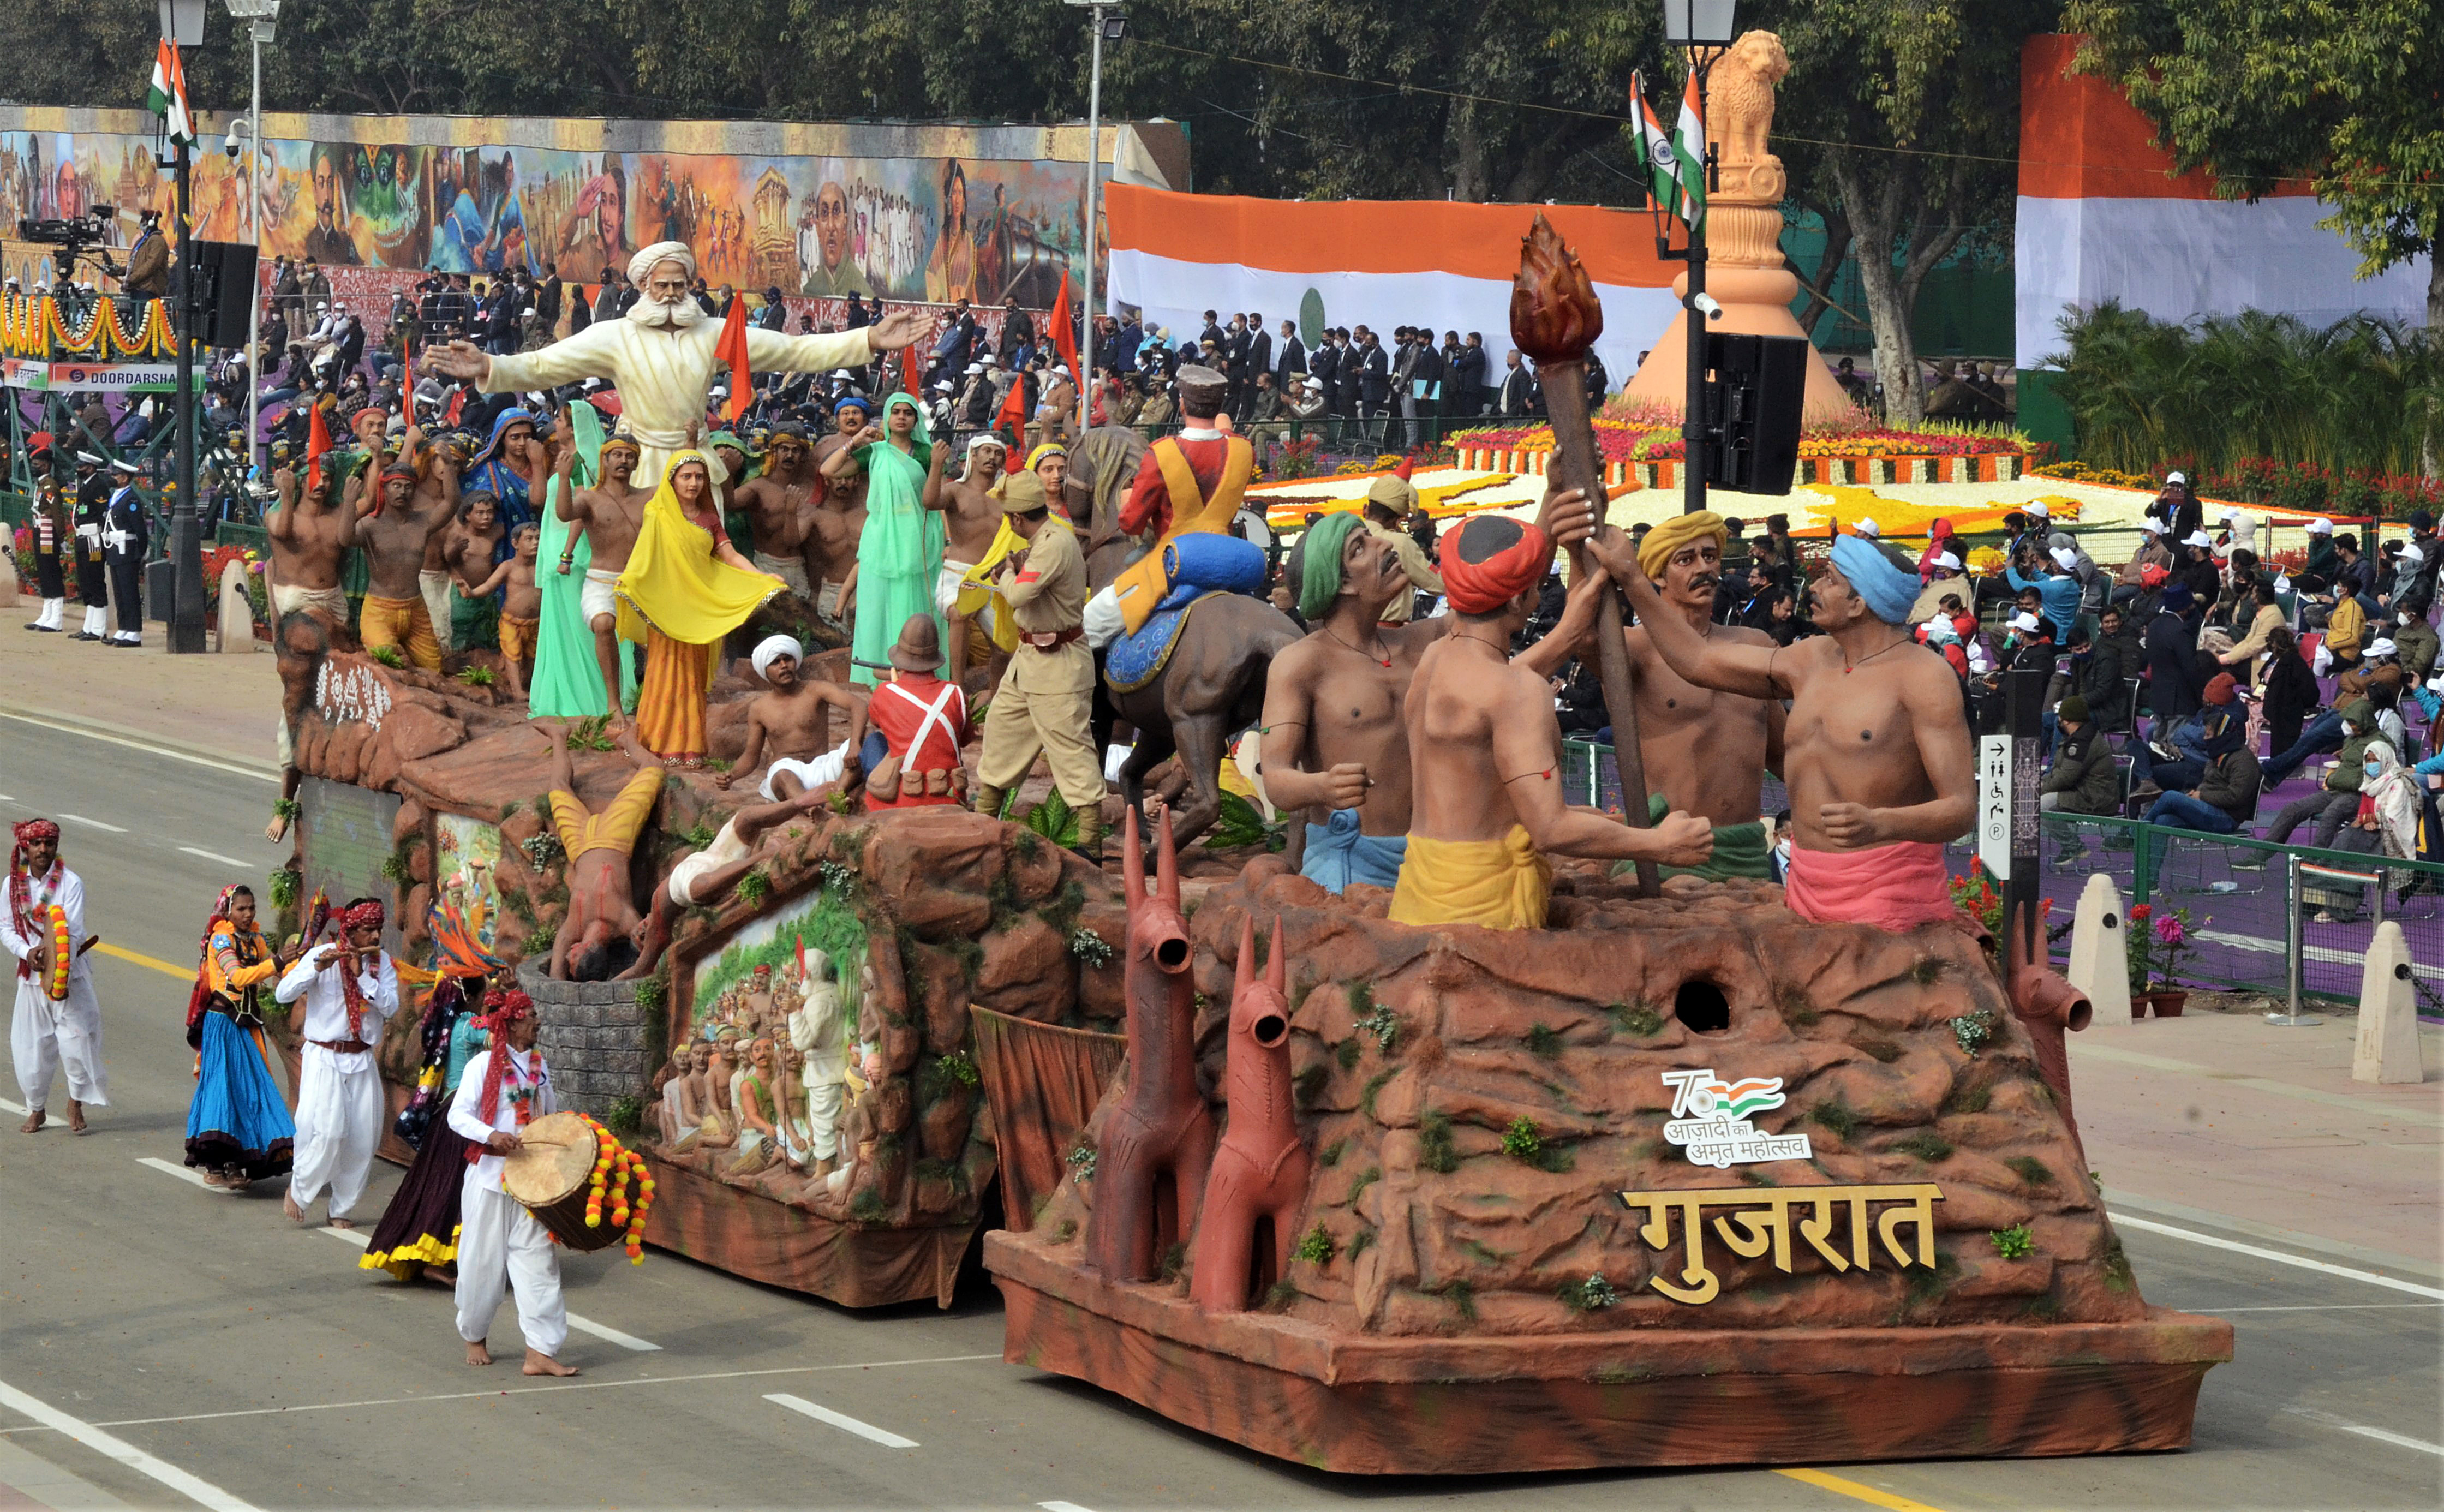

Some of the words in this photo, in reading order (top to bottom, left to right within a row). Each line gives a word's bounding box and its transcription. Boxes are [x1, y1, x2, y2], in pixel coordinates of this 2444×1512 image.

[91, 372, 177, 384] DOORDARSHA
[1668, 1115, 1730, 1141] आज़ादी
[1732, 1125, 1748, 1137] का
[1692, 1143, 1735, 1165] अमृत
[1739, 1134, 1805, 1160] महोत्सव
[1621, 1183, 1945, 1305] गुजरात
